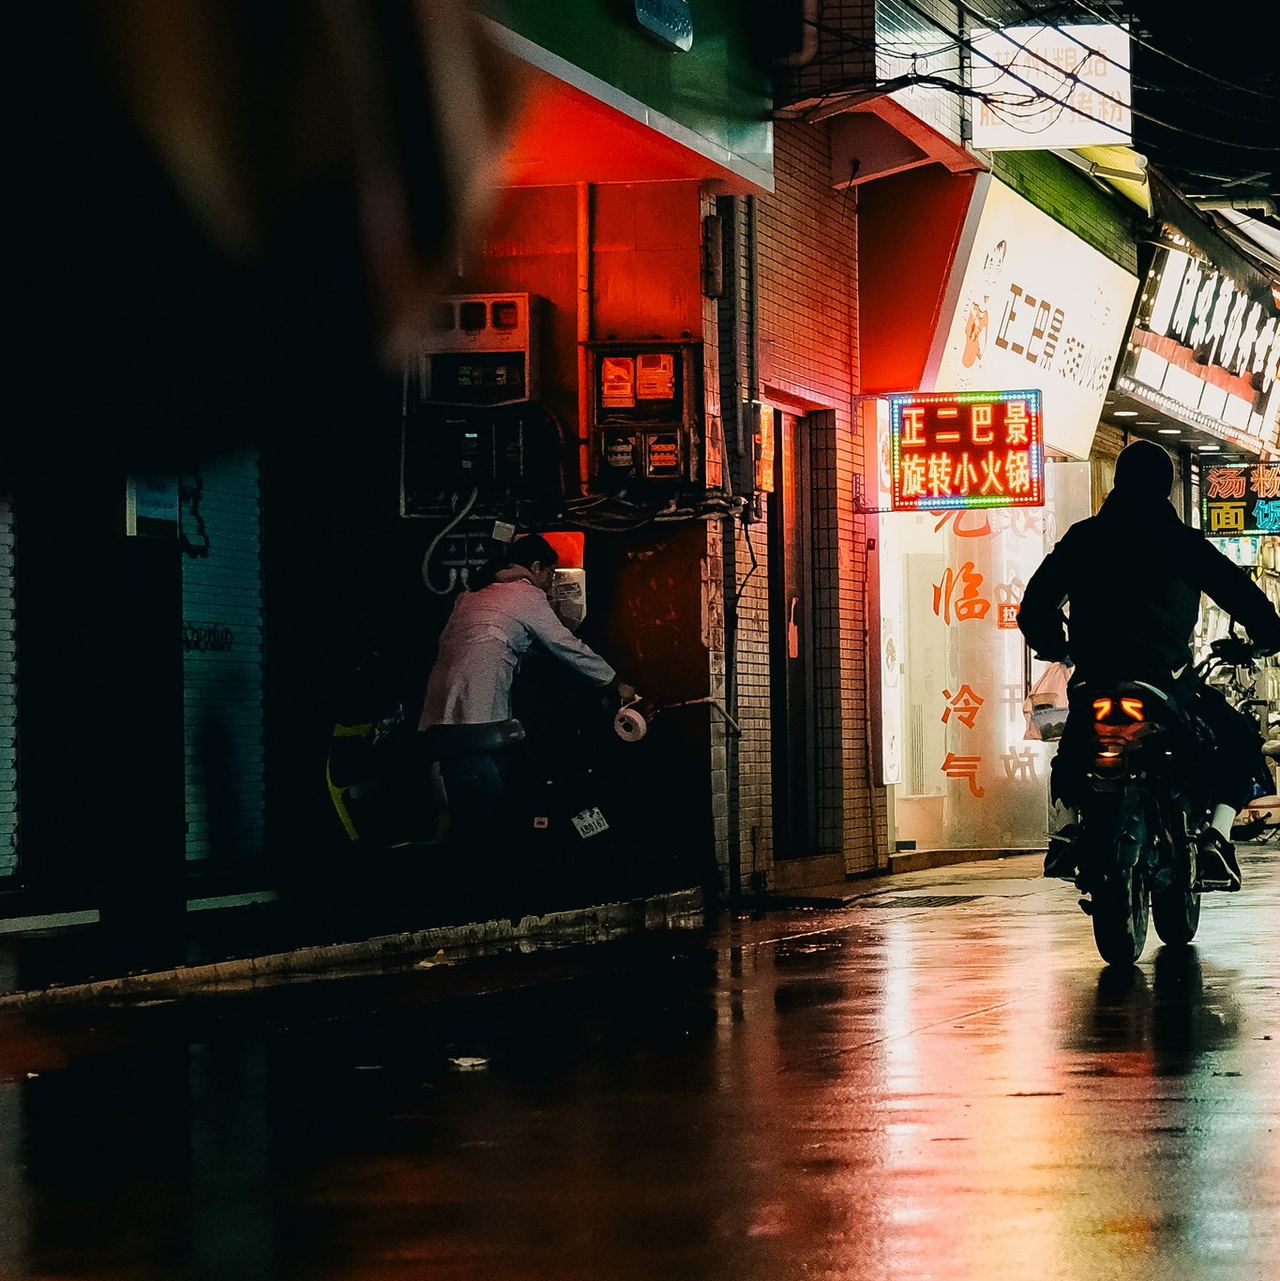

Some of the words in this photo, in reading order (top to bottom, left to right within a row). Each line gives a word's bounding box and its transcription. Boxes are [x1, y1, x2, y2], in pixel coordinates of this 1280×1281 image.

[901, 400, 1030, 447] 正二巴景
[901, 450, 1031, 497] 旋转小火锅
[941, 684, 985, 799] 冷气
